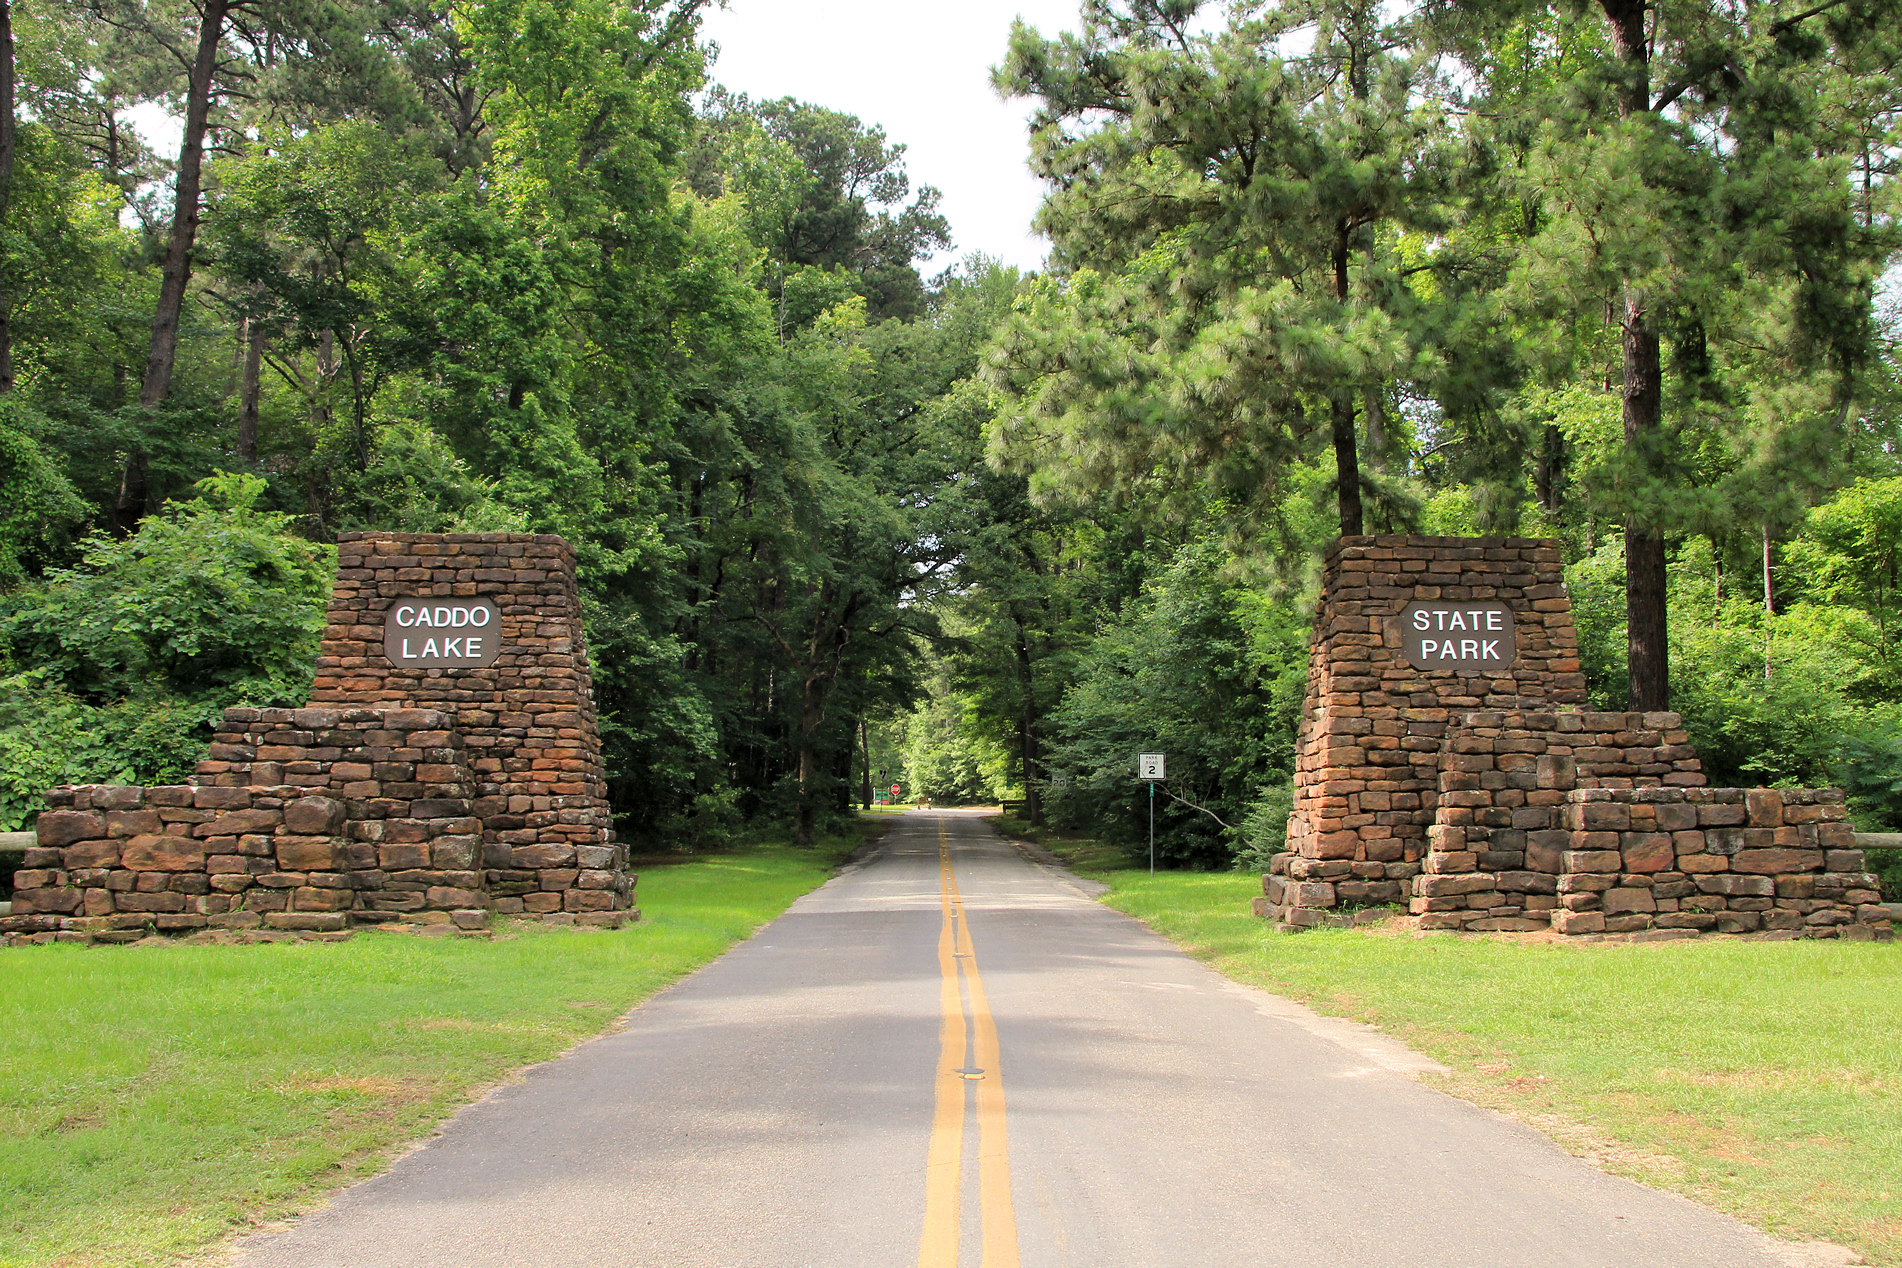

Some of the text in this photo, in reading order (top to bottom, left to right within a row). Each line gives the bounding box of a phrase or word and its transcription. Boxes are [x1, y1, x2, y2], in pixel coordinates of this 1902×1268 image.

[396, 606, 491, 627] CADDO
[1412, 610, 1503, 631] STATE
[402, 637, 483, 659] LAKE
[1421, 639, 1501, 660] PARK
[1148, 765, 1156, 774] 2
